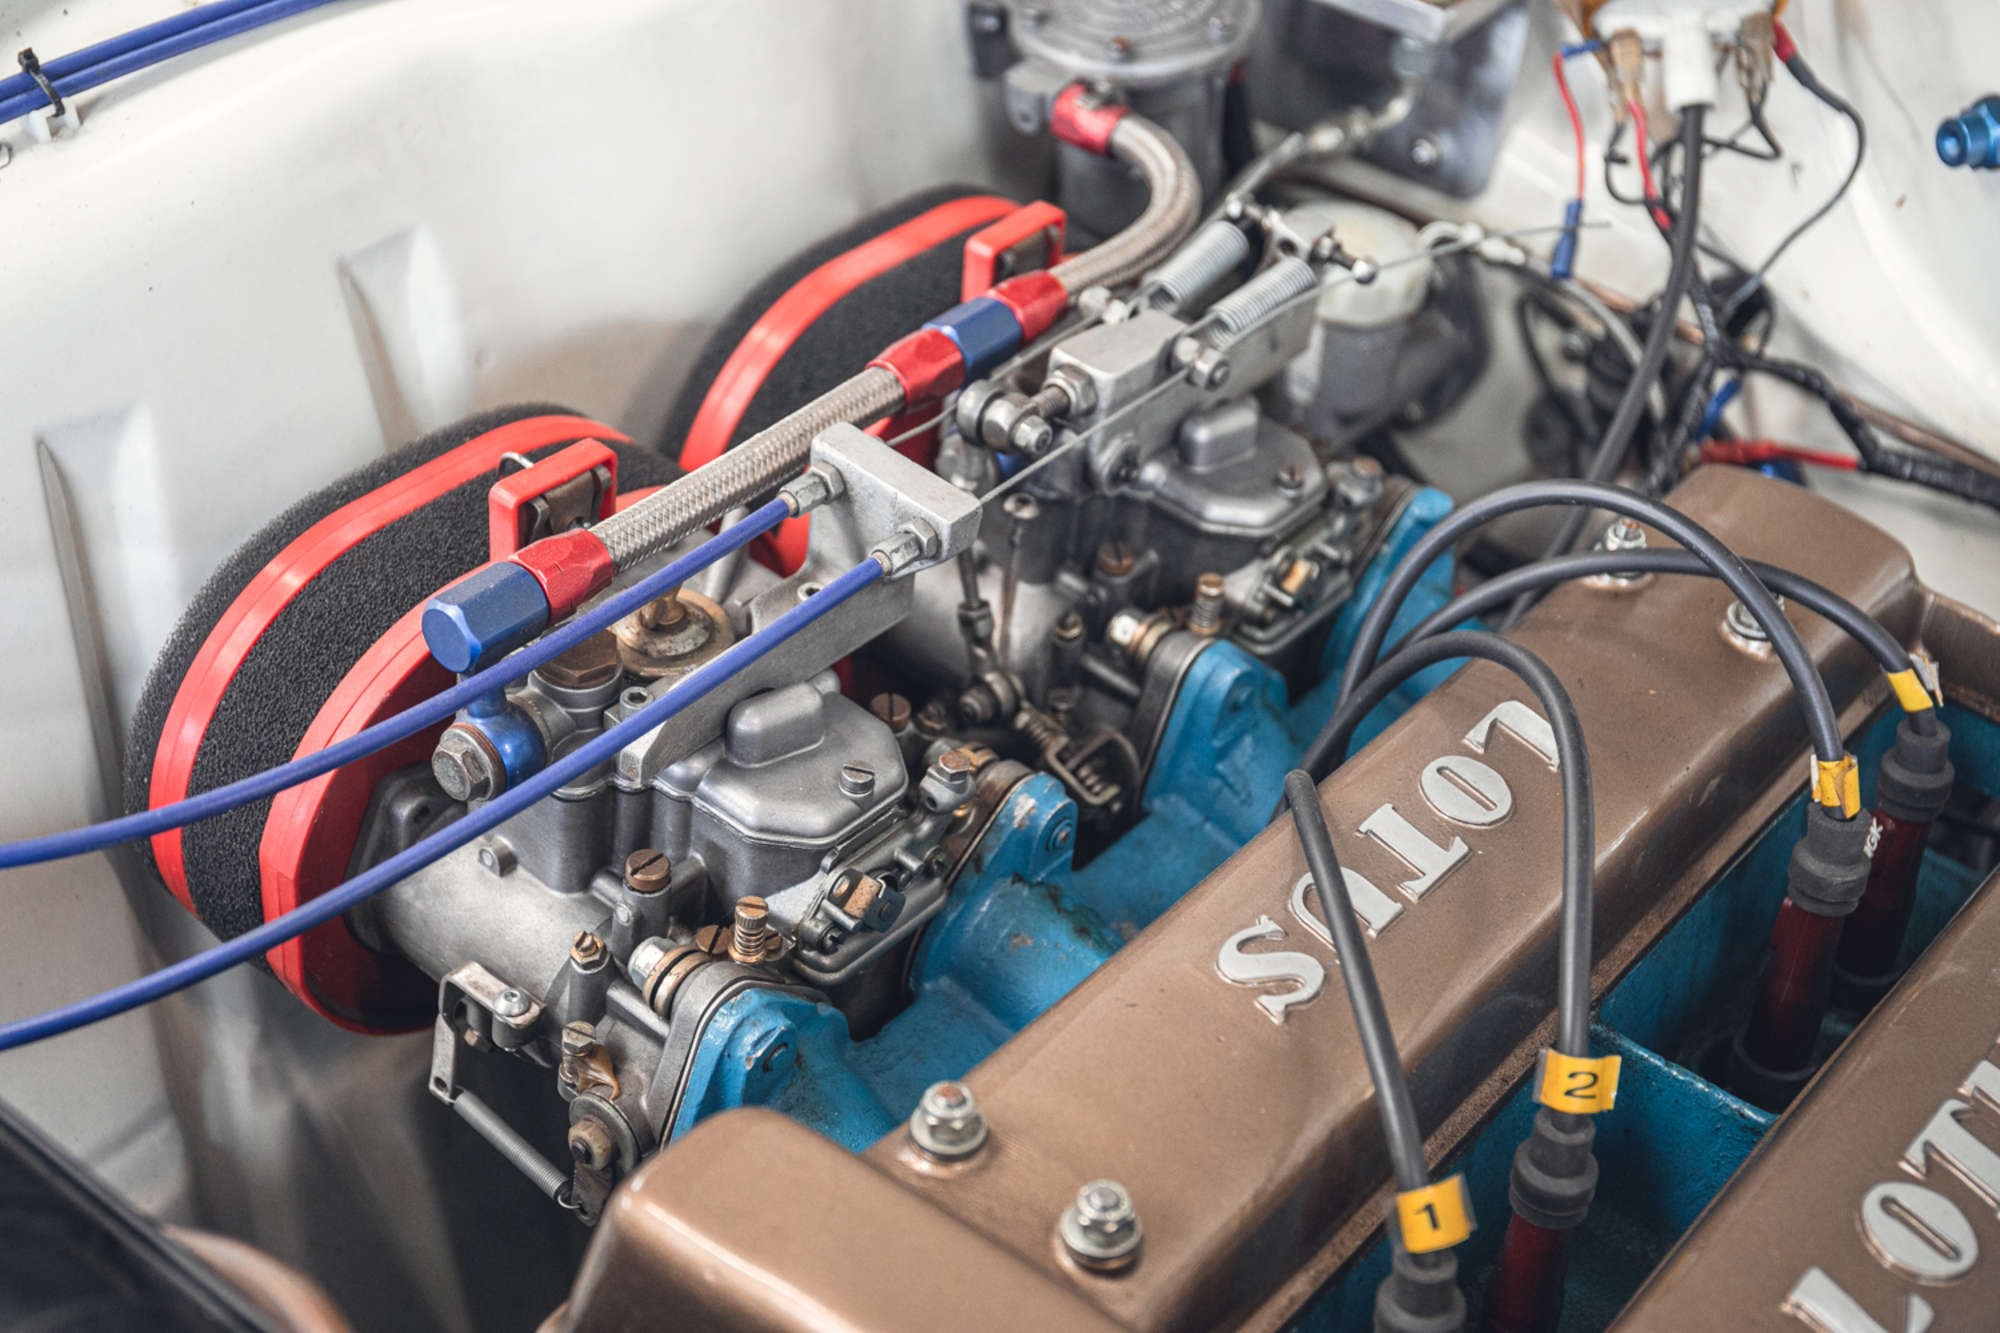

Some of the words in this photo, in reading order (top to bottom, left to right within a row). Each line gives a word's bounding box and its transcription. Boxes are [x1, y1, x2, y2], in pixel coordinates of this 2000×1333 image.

[1215, 699, 1562, 1024] LOTUS
[1563, 1070, 1599, 1100] 2
[1413, 1202, 1440, 1231] 1
